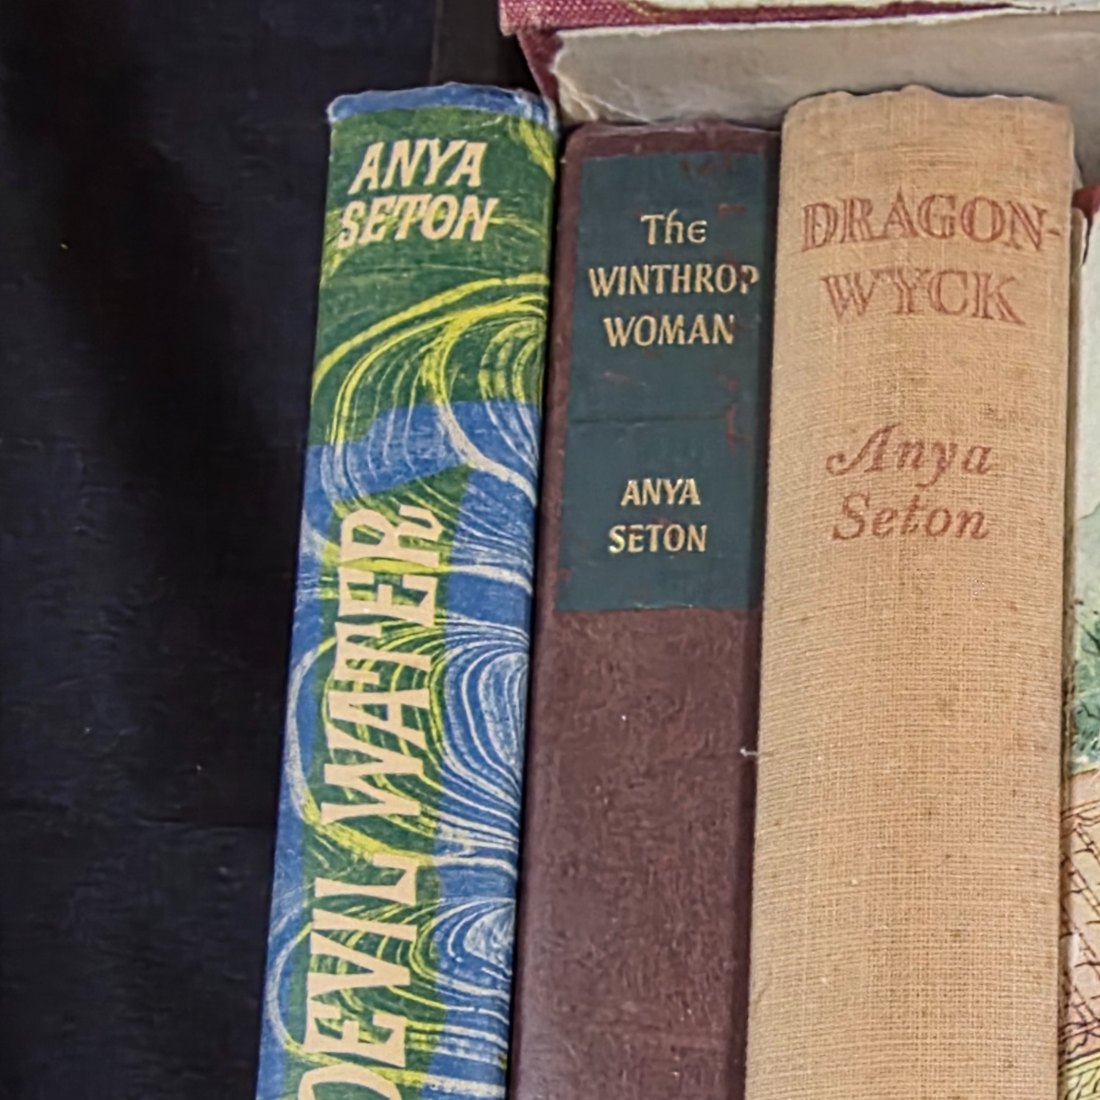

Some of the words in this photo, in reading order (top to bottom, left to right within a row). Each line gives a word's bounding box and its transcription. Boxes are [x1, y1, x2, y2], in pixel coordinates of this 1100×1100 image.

[349, 138, 487, 194] ANYA
[338, 194, 498, 249] SETON
[641, 209, 707, 244] The
[801, 192, 1061, 252] DRAGON-
[588, 264, 759, 297] WINTHROP
[820, 267, 1026, 326] WYCK
[603, 314, 734, 347] WOMAN
[826, 424, 993, 488] Anya
[621, 478, 701, 506] ANYA
[832, 492, 990, 542] Seton
[608, 523, 707, 554] SETON
[320, 503, 445, 825] WATER
